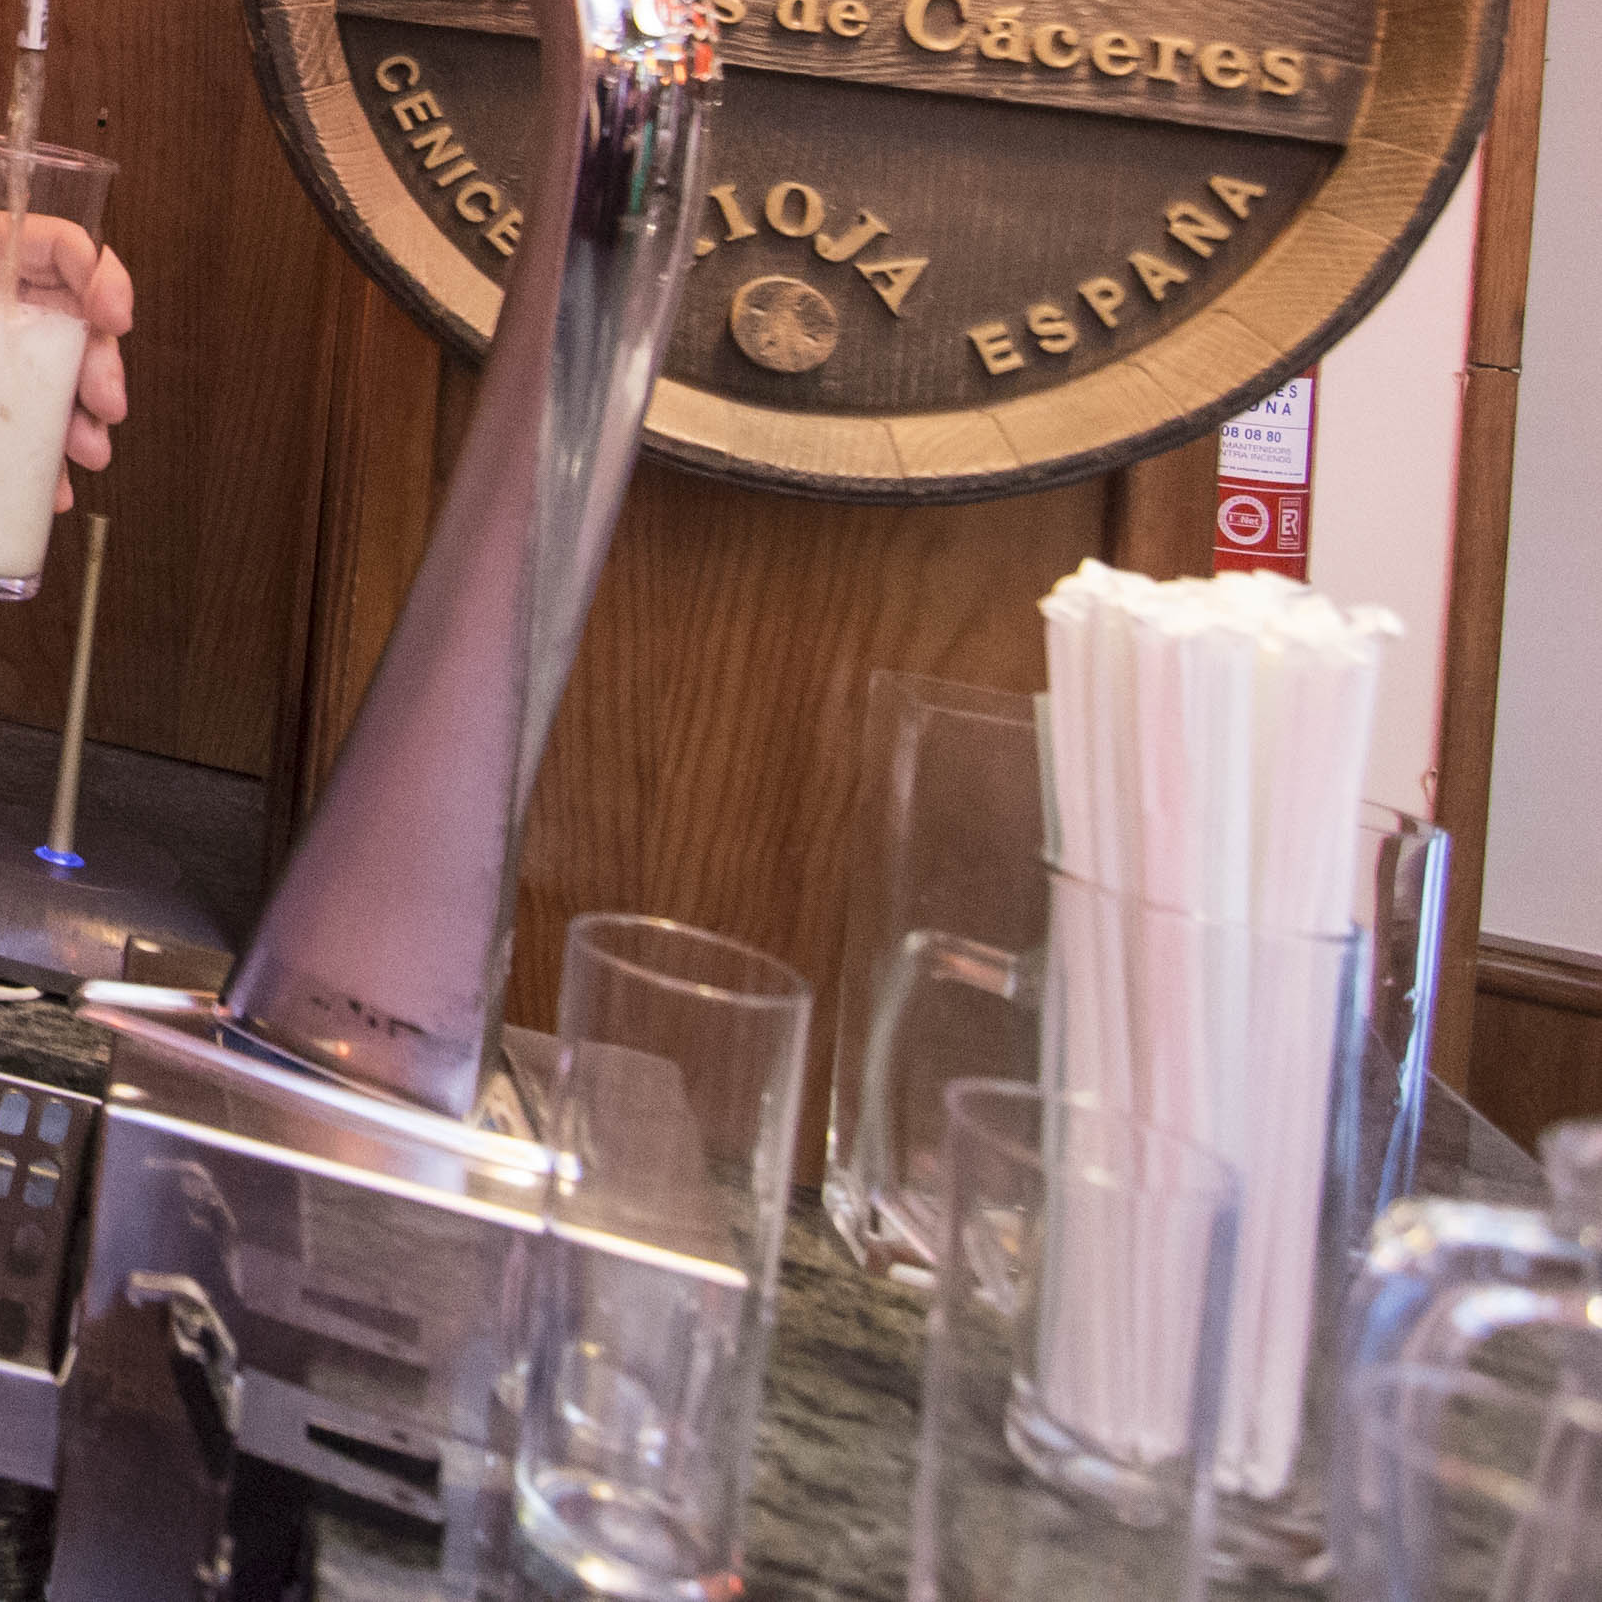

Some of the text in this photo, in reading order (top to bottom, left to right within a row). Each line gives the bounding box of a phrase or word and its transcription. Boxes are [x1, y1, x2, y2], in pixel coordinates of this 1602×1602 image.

[375, 54, 525, 258] CENICE
[693, 182, 929, 318] IOJA
[967, 174, 1268, 376] ESPAÑA
[1245, 428, 1262, 441] 08
[1267, 430, 1282, 443] 80
